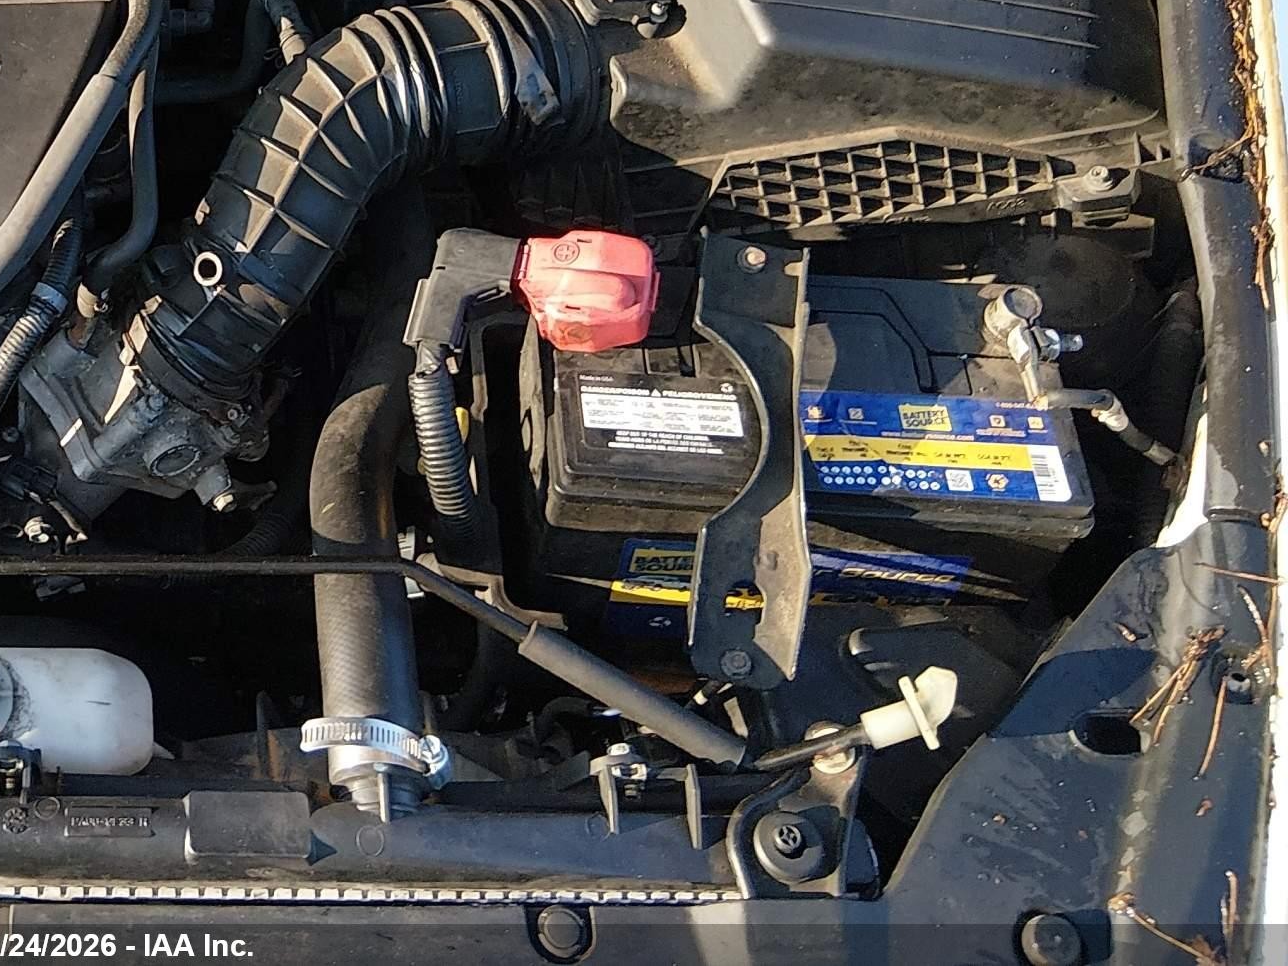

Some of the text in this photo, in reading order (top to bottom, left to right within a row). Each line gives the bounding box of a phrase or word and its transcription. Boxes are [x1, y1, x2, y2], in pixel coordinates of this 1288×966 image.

[903, 409, 945, 420] BATTERY
[905, 417, 947, 427] SOURCE
[635, 555, 695, 564] BATTE
[635, 563, 694, 571] SOUR
[839, 567, 957, 583] Source
